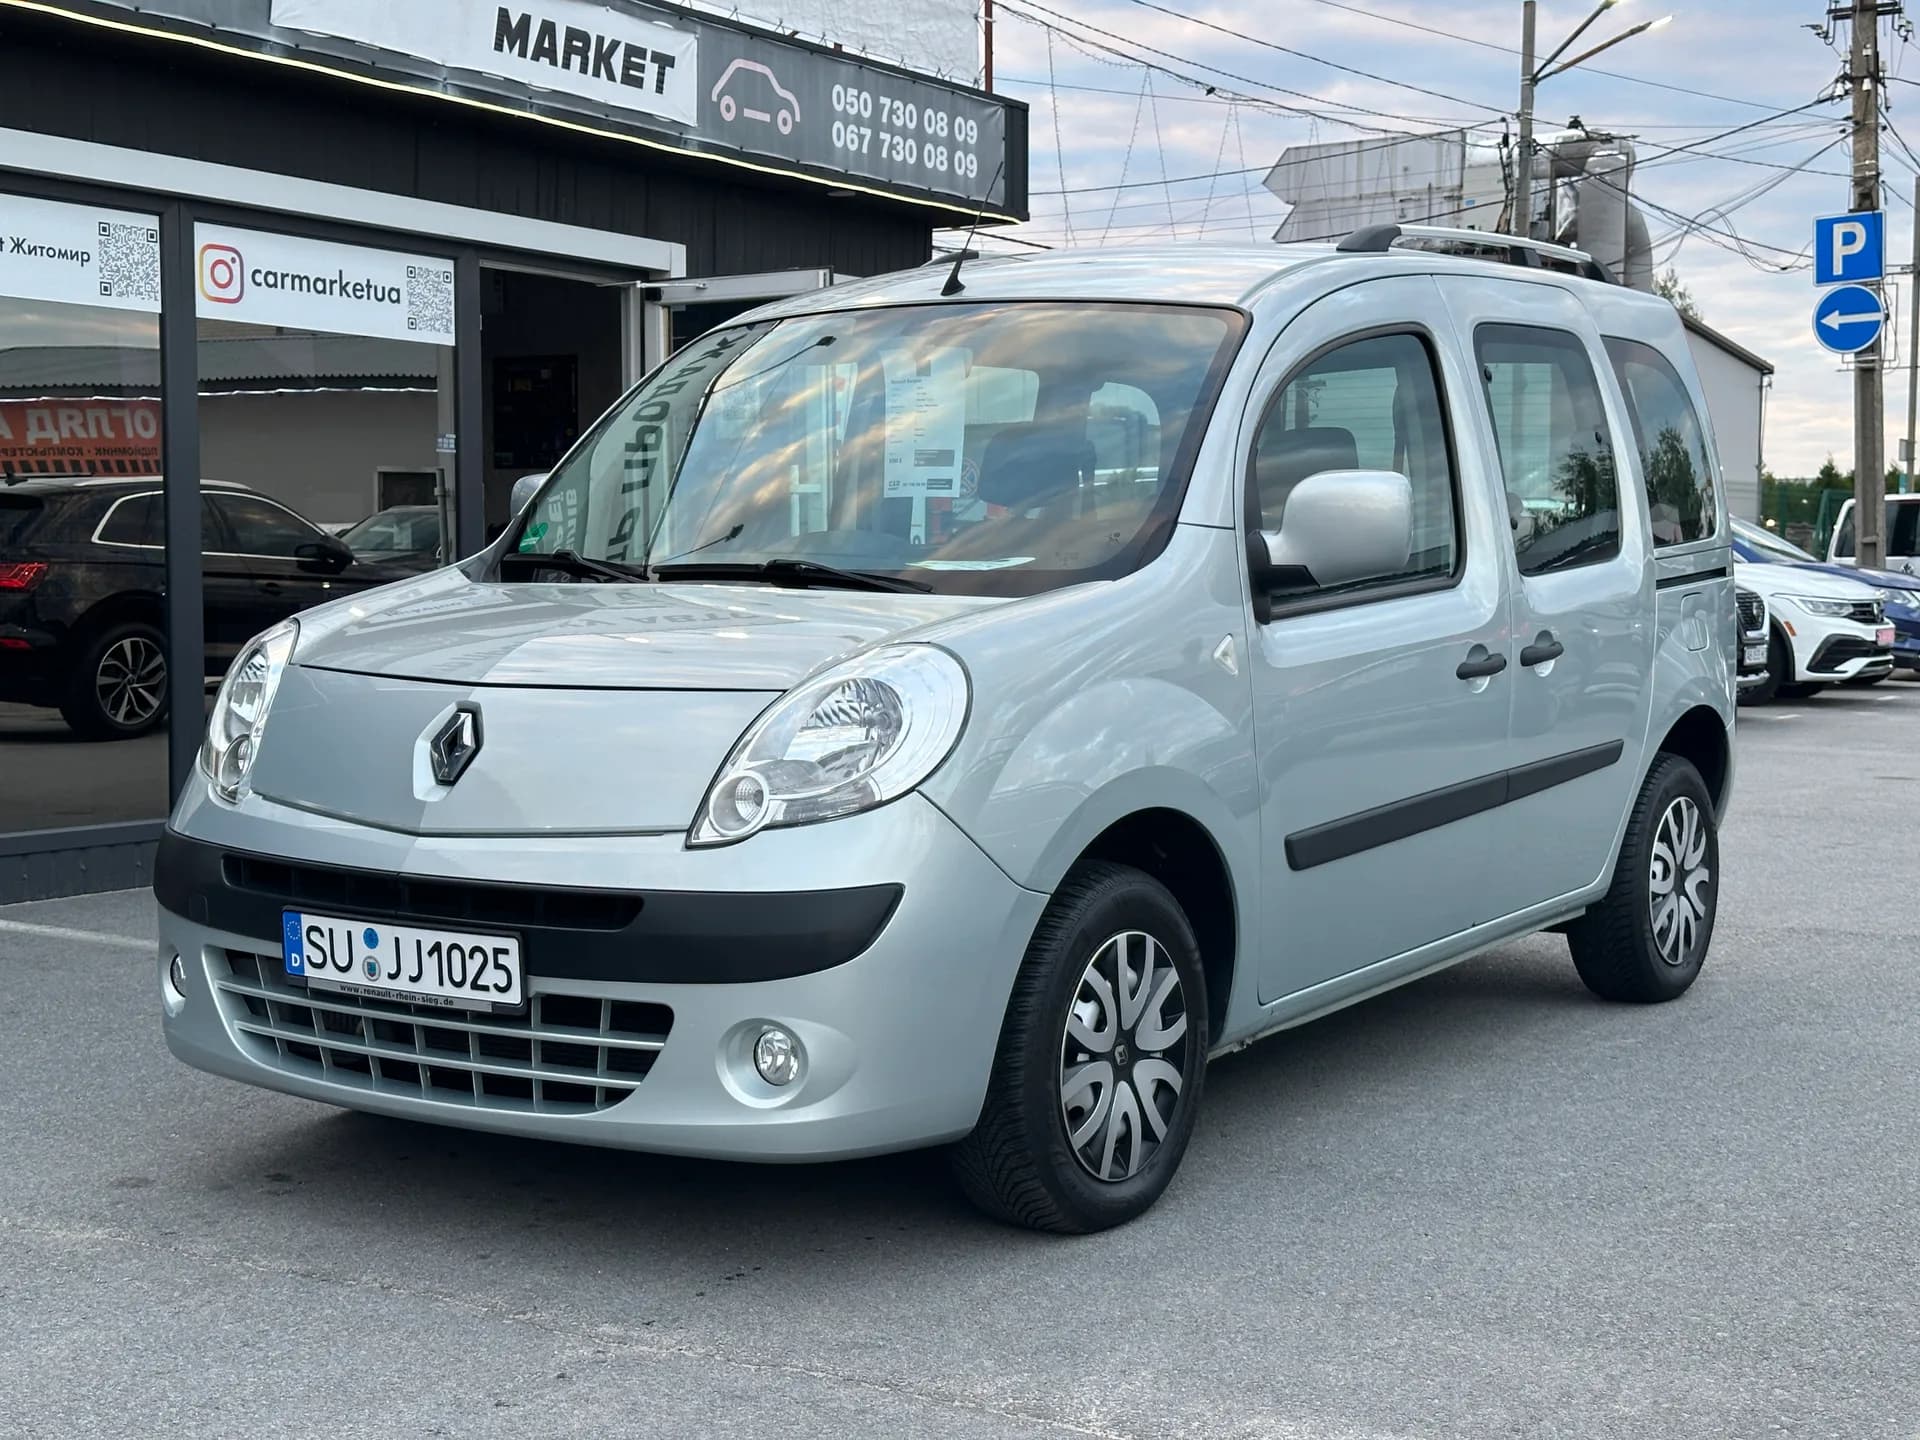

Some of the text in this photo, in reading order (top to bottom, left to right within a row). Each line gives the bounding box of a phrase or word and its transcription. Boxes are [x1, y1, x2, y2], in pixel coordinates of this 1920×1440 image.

[494, 6, 676, 95] MARKET
[832, 84, 977, 144] 050 730 08 09
[832, 121, 977, 178] 067 730 08 09
[10, 236, 91, 267] Житомир
[1832, 221, 1866, 276] P
[251, 268, 401, 304] carmarketua
[291, 925, 512, 993] D SU JJ1025
[339, 984, 454, 1007] www.renault-rhein-sieg.de
